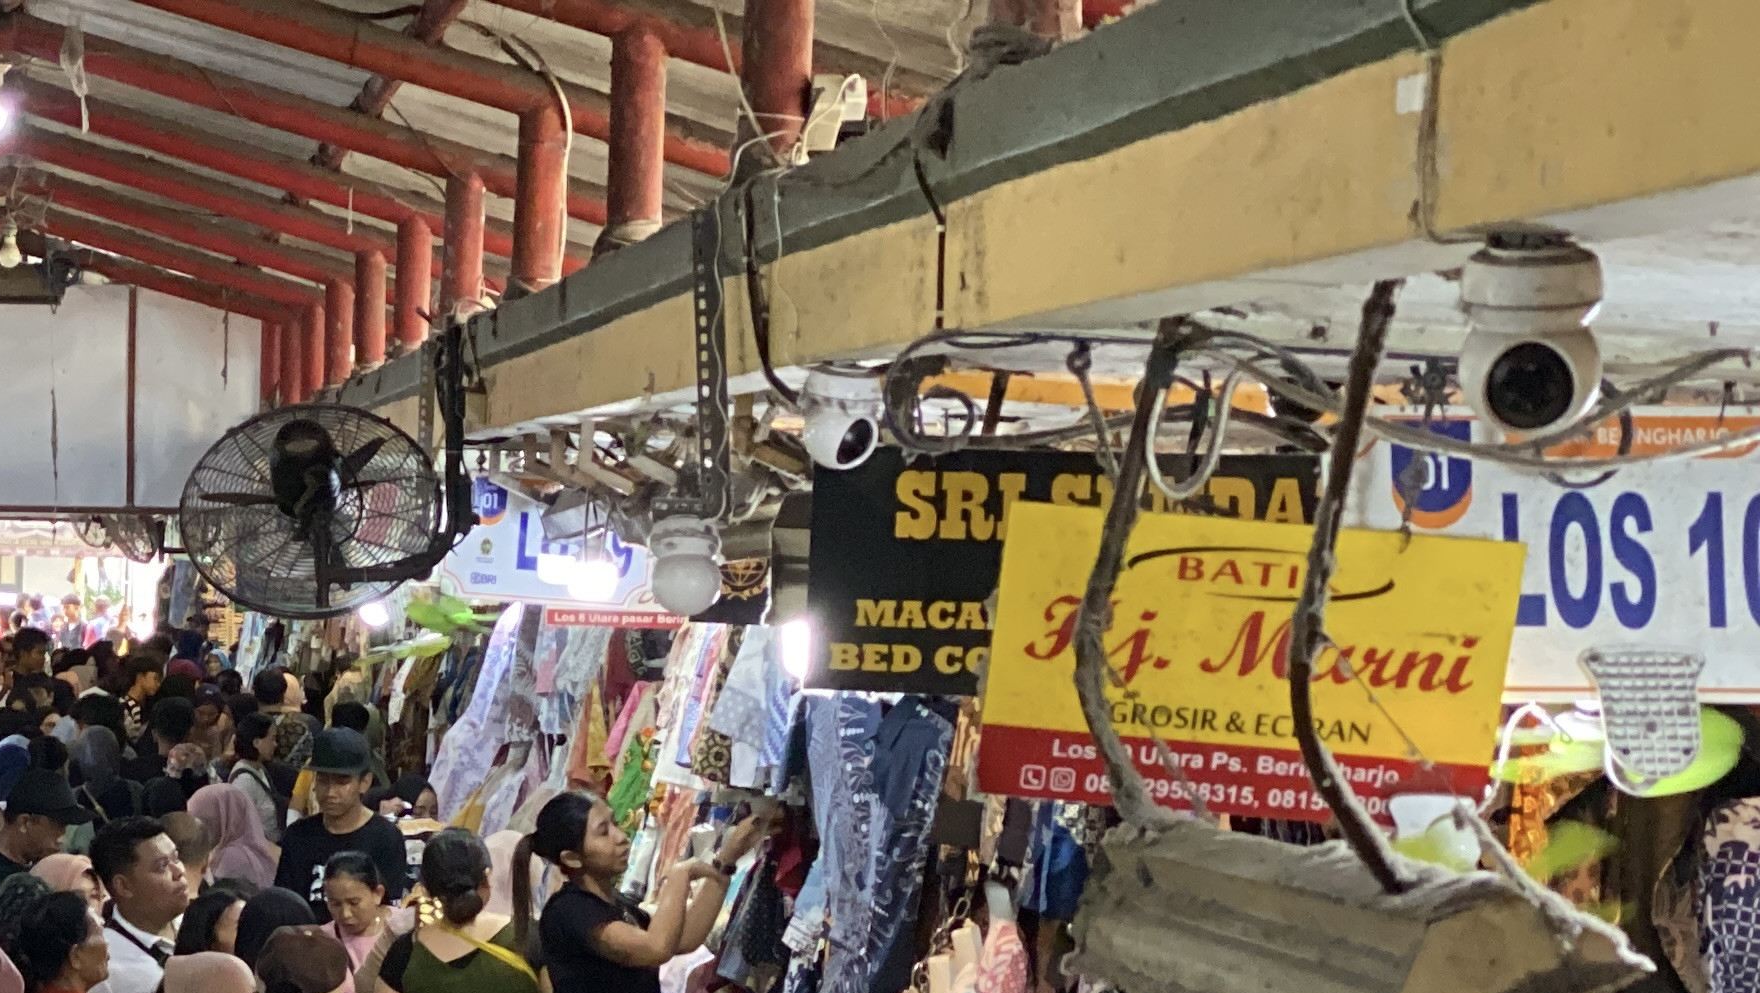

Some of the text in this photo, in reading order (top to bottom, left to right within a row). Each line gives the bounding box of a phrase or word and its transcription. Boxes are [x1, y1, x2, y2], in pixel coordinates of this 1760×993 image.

[1177, 555, 1306, 591] BATI
[855, 599, 992, 630] MACA
[830, 642, 990, 675] BED CO
[1108, 700, 1216, 736] GROSIR
[1052, 738, 1098, 761] Los
[1210, 751, 1248, 773] Ps.
